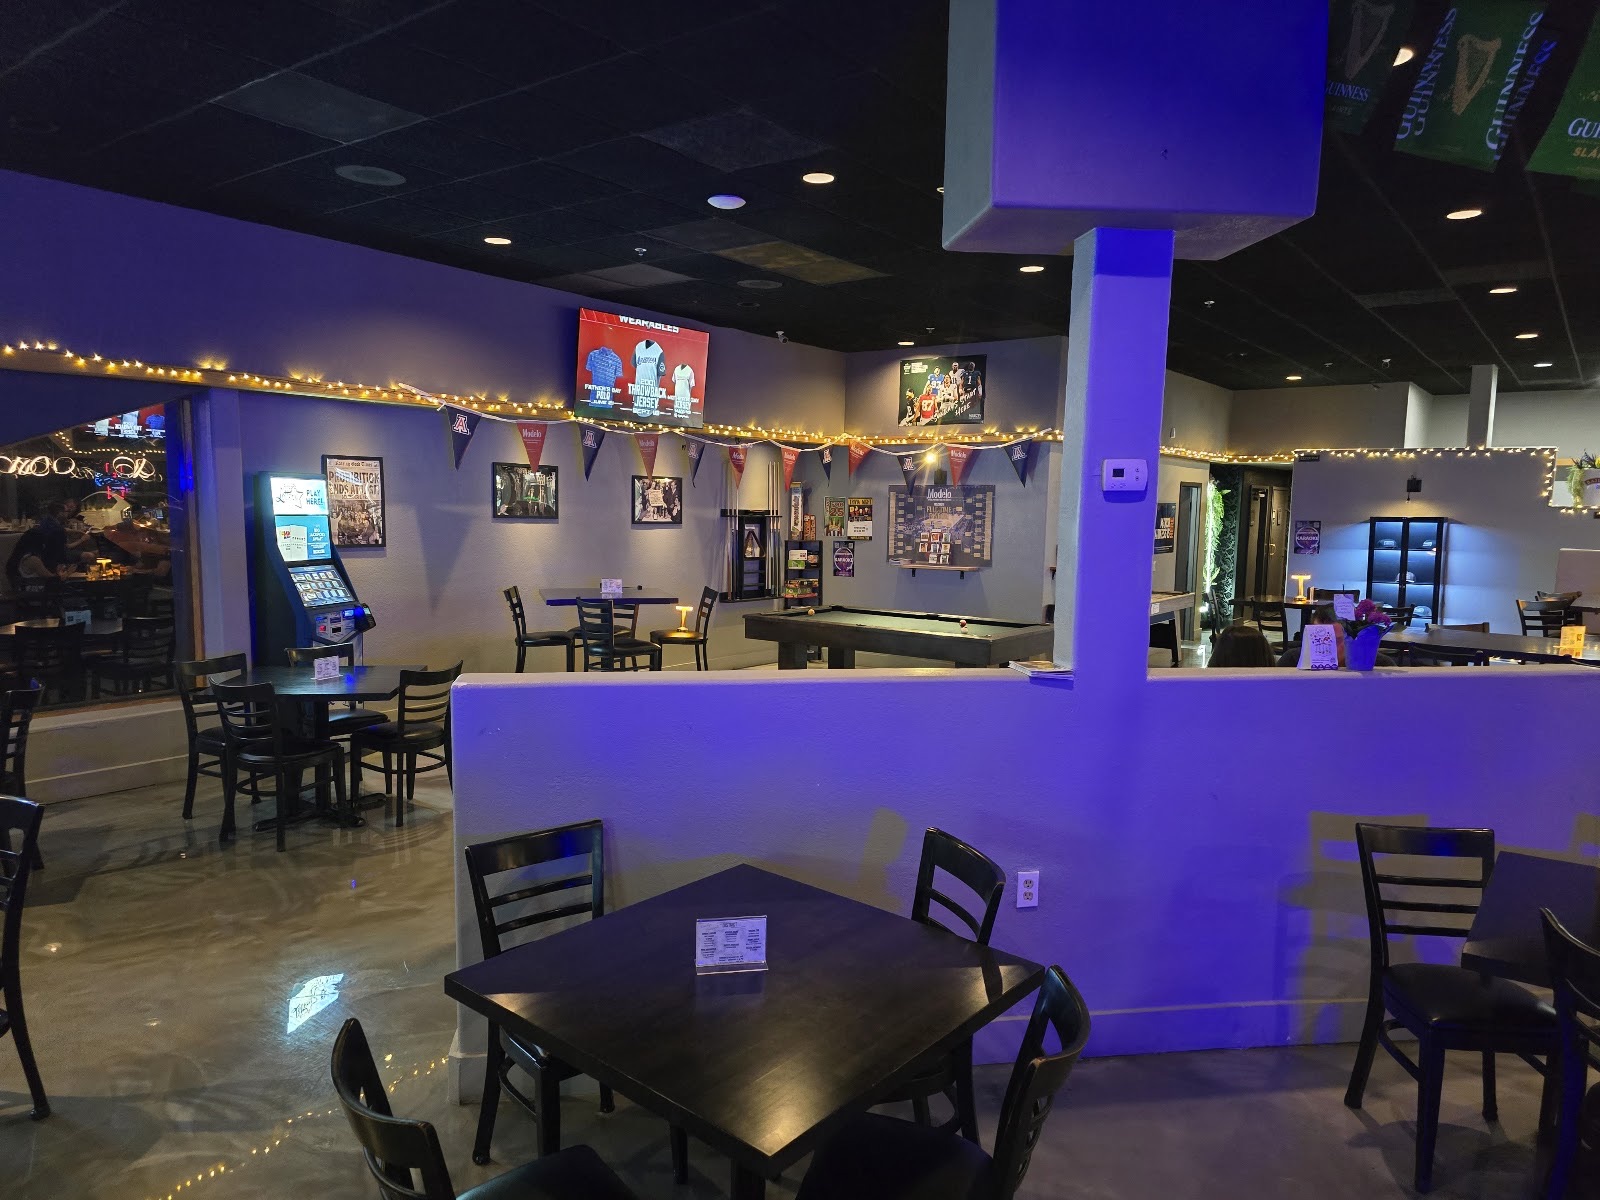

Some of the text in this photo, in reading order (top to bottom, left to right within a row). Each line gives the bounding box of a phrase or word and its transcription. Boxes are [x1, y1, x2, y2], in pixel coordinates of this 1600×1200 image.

[1325, 82, 1369, 102] UINNESS
[619, 315, 680, 334] WEARABLES
[596, 391, 611, 401] POLO
[627, 383, 667, 399] THROWBACK
[634, 396, 660, 409] JERSEY
[452, 414, 470, 435] A
[522, 428, 542, 438] Modelo
[951, 449, 967, 459] Modelo
[328, 471, 379, 484] PIBITION
[306, 489, 320, 497] PLAY
[926, 488, 952, 500] Modelo
[306, 498, 323, 506] HERE!
